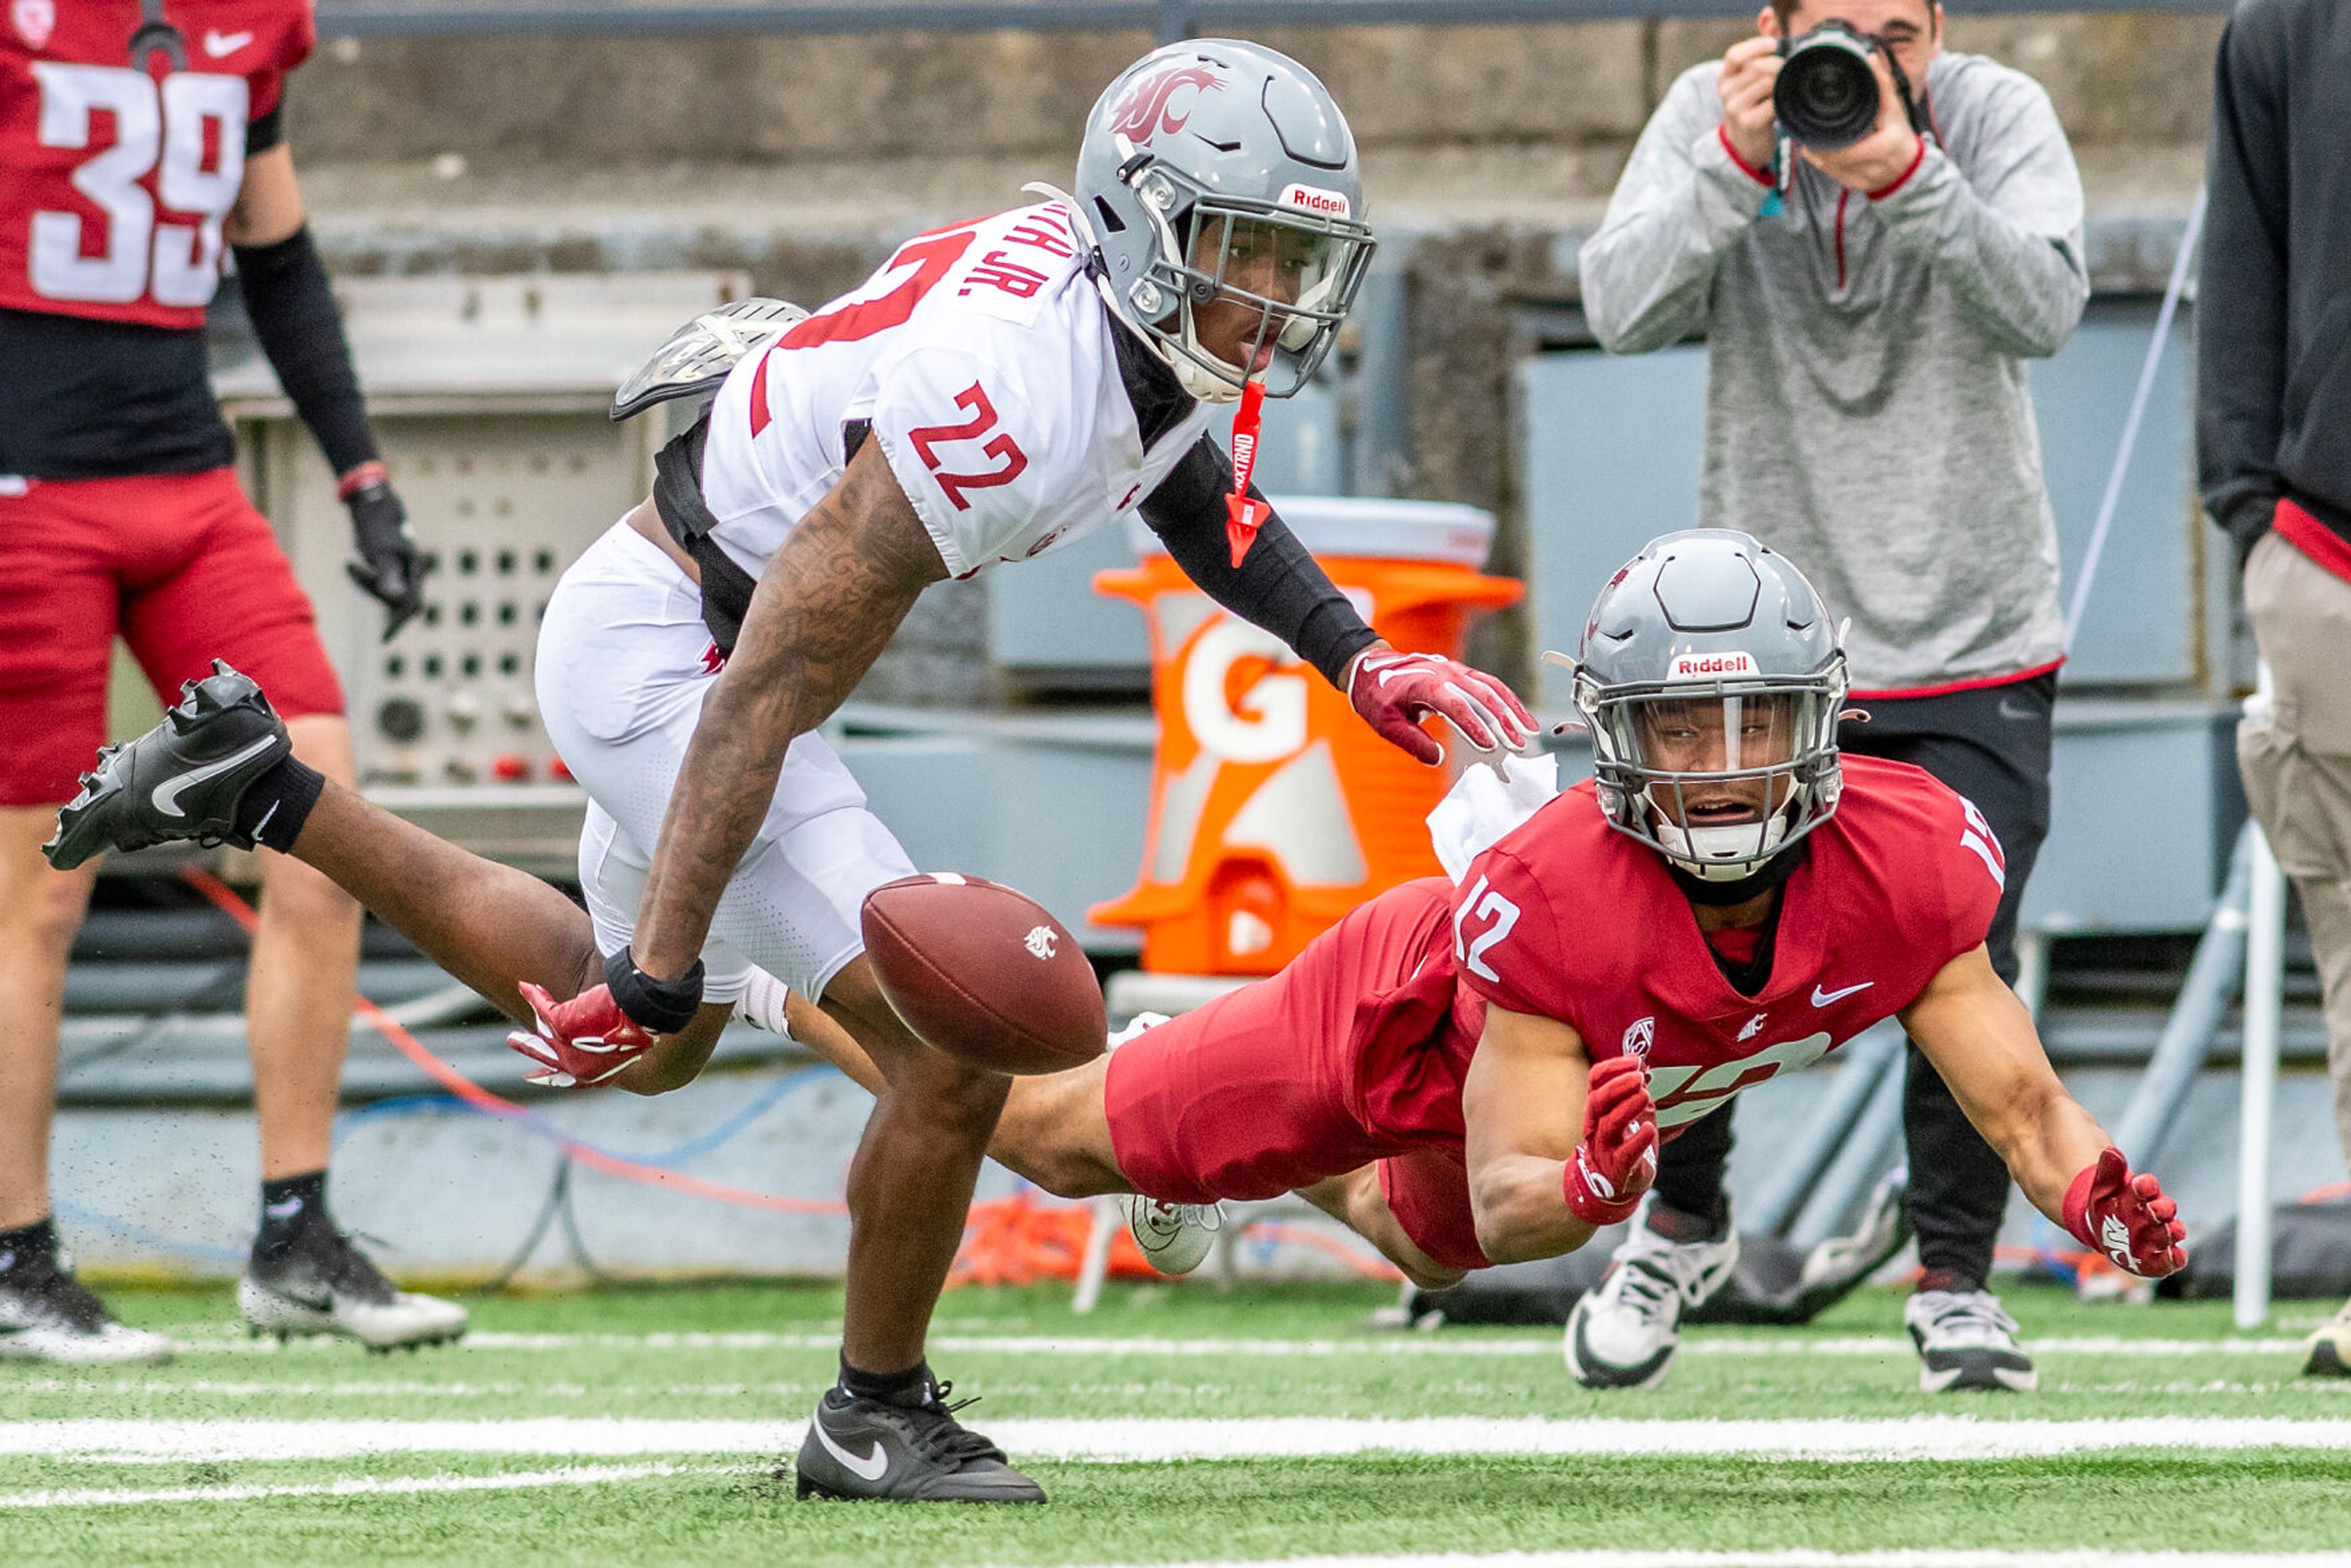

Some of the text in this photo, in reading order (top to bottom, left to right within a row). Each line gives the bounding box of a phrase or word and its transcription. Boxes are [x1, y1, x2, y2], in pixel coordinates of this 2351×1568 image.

[28, 61, 250, 306] 39
[958, 250, 1050, 299] JR.
[908, 378, 1029, 512] 22
[1234, 433, 1254, 489] NXTRND
[1182, 613, 1308, 763] G
[1679, 656, 1747, 674] Riddell
[1455, 874, 1521, 984] 12
